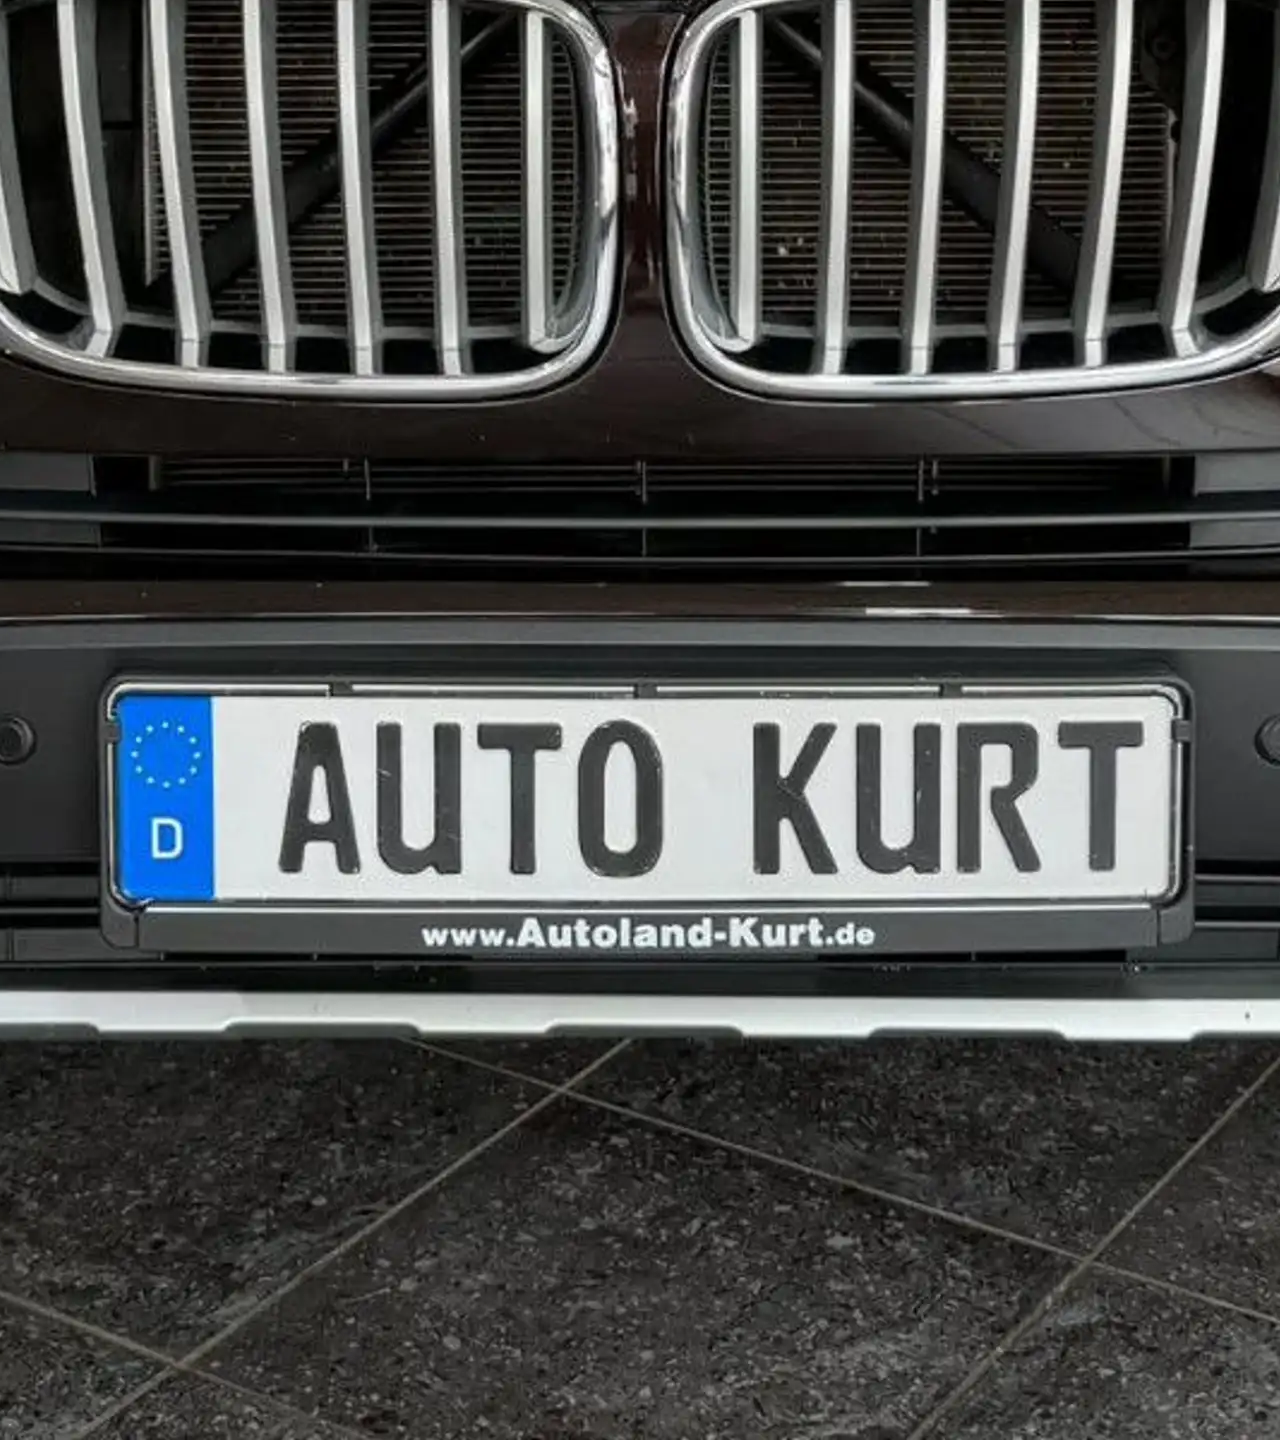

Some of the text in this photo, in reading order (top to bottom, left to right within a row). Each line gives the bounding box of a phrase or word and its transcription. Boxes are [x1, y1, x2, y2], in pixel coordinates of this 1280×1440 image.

[278, 718, 1144, 878] AUTO KURT
[151, 817, 184, 860] D
[420, 917, 876, 949] www.Autoland-Kurt.de
